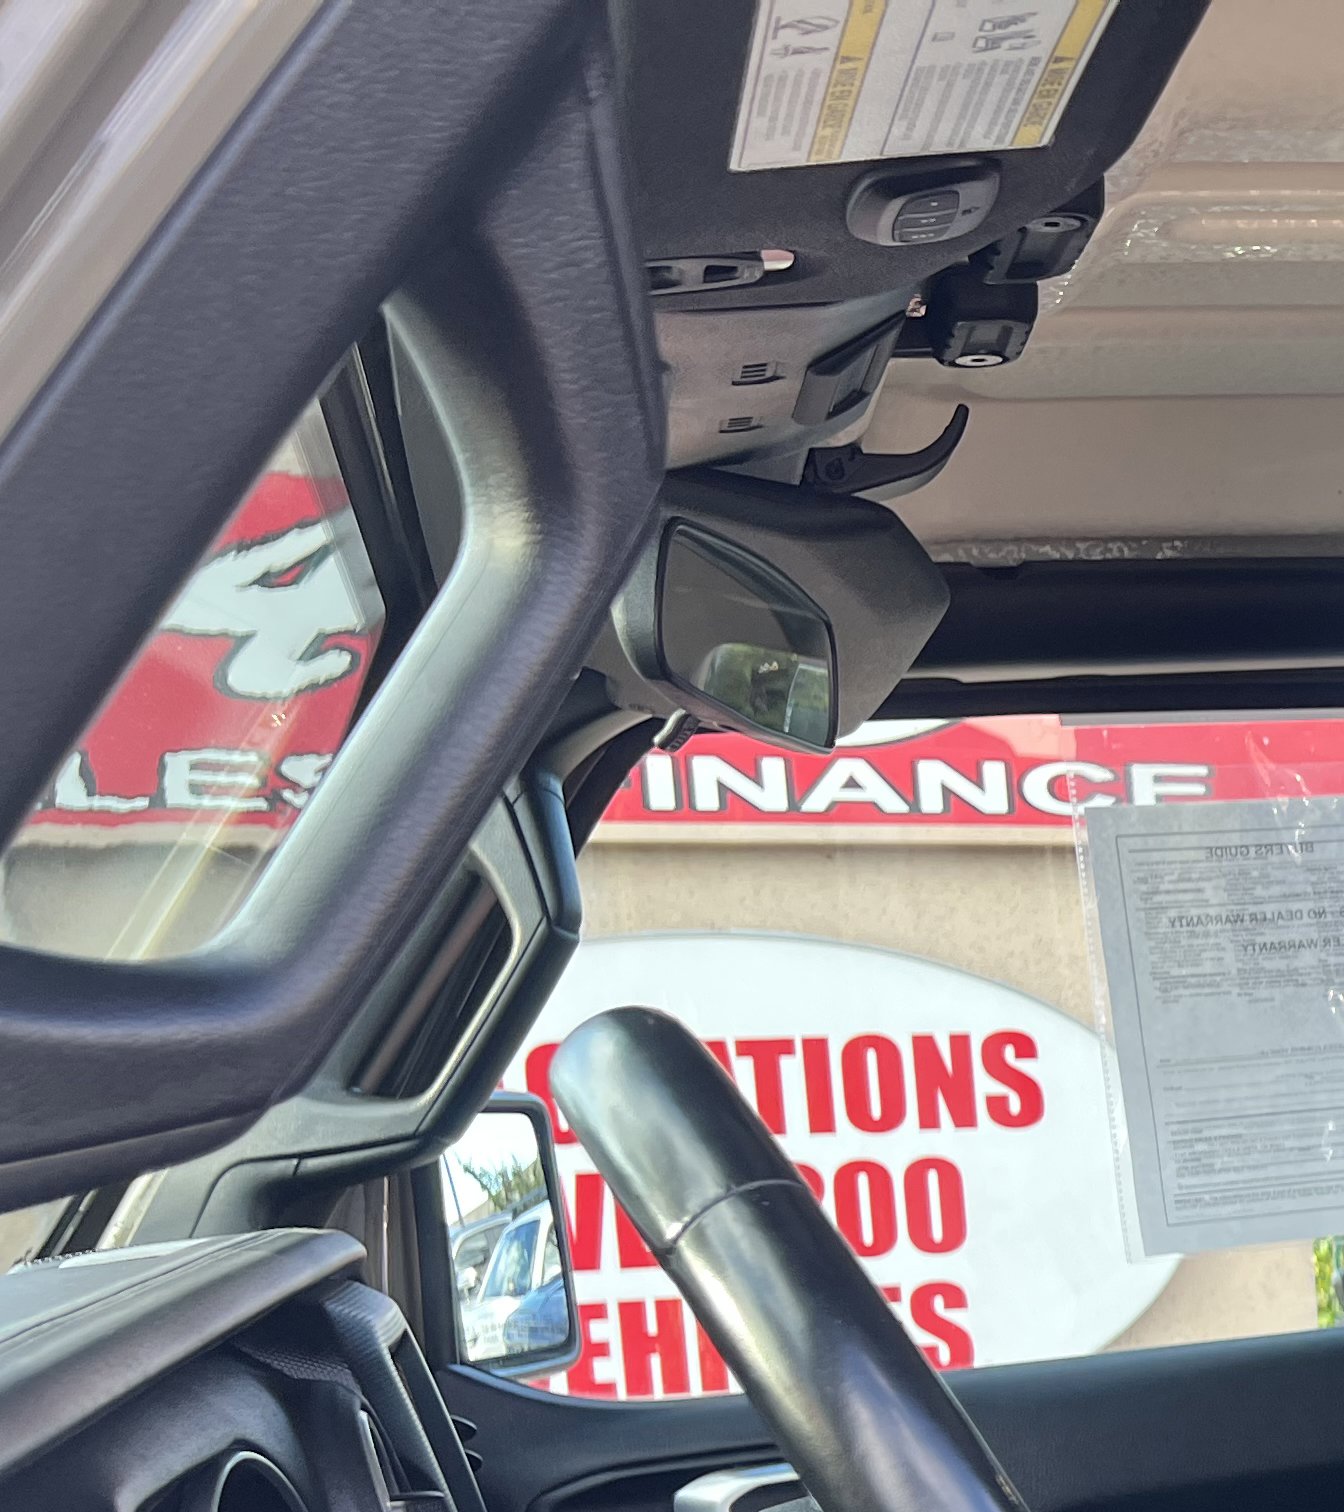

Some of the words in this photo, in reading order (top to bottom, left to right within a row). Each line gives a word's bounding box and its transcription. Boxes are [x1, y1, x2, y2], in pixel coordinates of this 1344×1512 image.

[33, 750, 333, 811] LES
[618, 753, 1212, 816] INANCE
[497, 1028, 1045, 1146] TIONS
[795, 1157, 968, 1258] 00
[525, 1282, 976, 1398] EHIS
